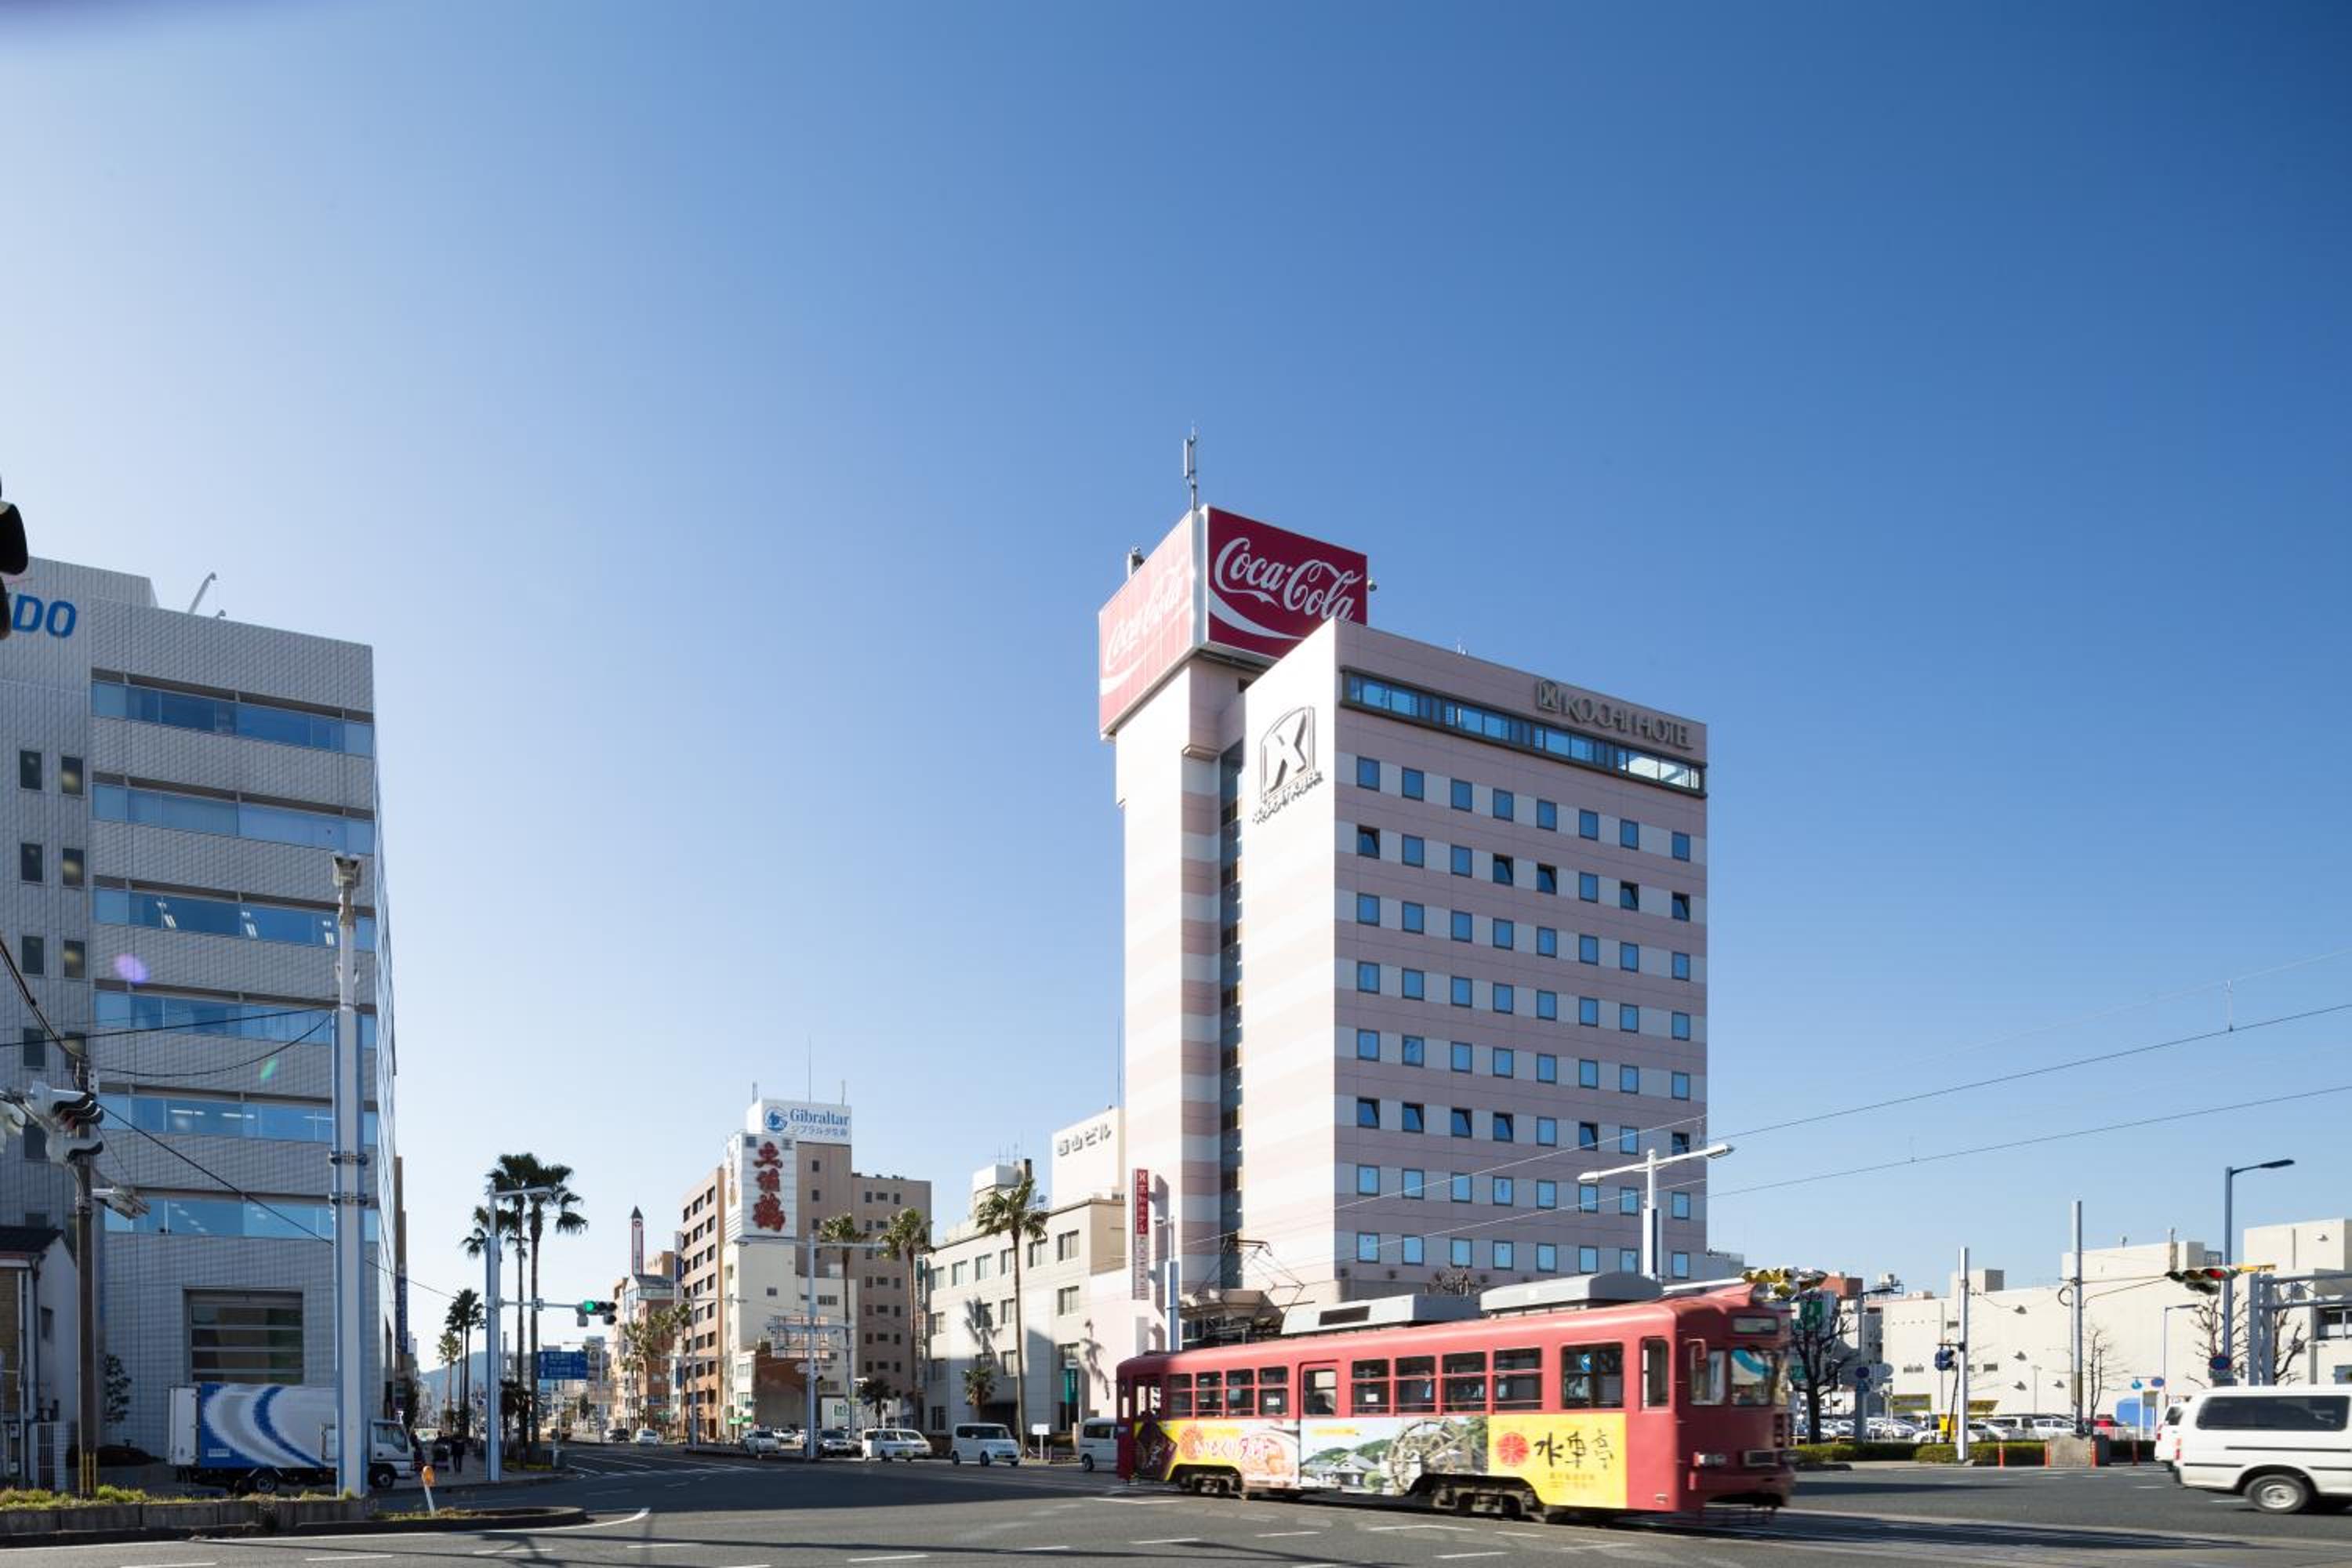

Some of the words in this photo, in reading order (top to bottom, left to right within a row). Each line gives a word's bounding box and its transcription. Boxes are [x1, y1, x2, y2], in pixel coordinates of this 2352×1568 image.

[1214, 537, 1363, 621] Coca-Cola
[1635, 713, 1693, 750] HOTEL
[789, 1109, 850, 1126] Gibraltar
